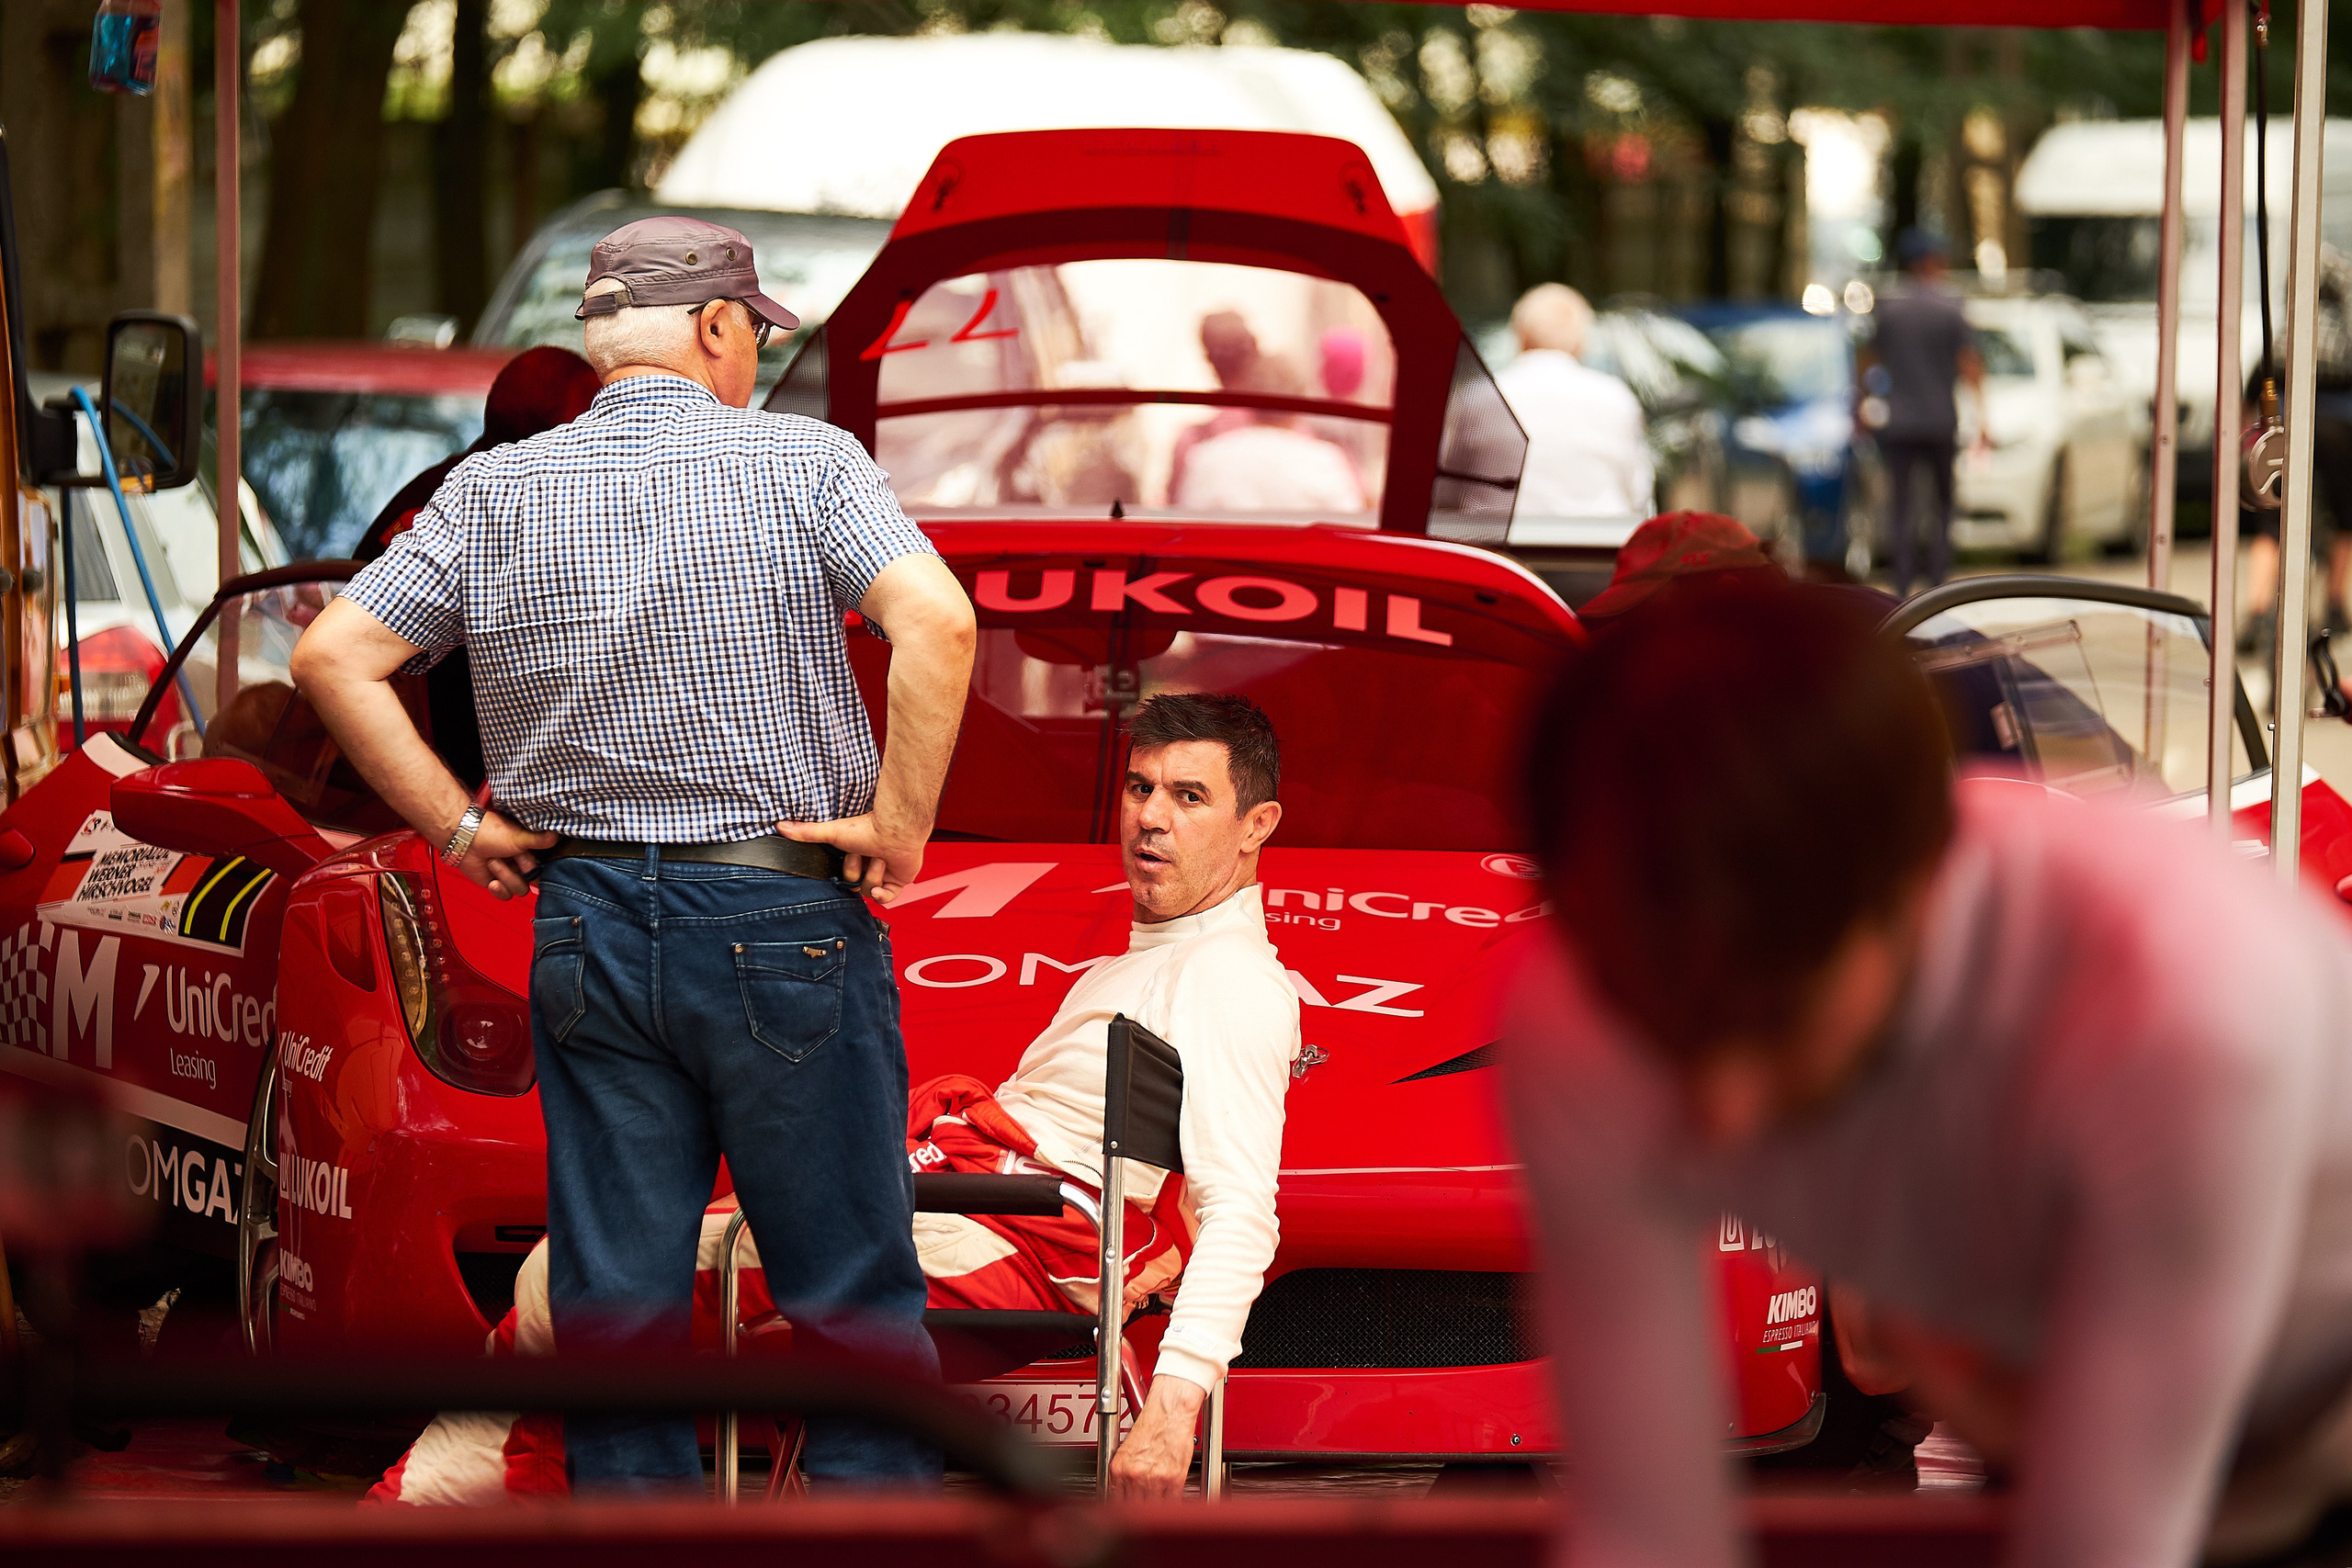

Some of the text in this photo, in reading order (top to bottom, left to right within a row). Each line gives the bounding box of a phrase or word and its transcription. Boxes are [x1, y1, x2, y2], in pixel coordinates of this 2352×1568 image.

[974, 568, 1453, 647] UKOIL
[87, 863, 137, 883] WERNER
[1264, 911, 1341, 931] sing
[166, 964, 277, 1049] UniCred
[170, 1047, 217, 1090] Leasing
[284, 1030, 334, 1083] UniCredit
[126, 1134, 243, 1225] OMGA
[290, 1154, 353, 1220] LUKOIL
[279, 1247, 314, 1293] KIMBO
[1767, 1285, 1816, 1325] KIMBO
[1762, 1325, 1793, 1343] ESPRESSO
